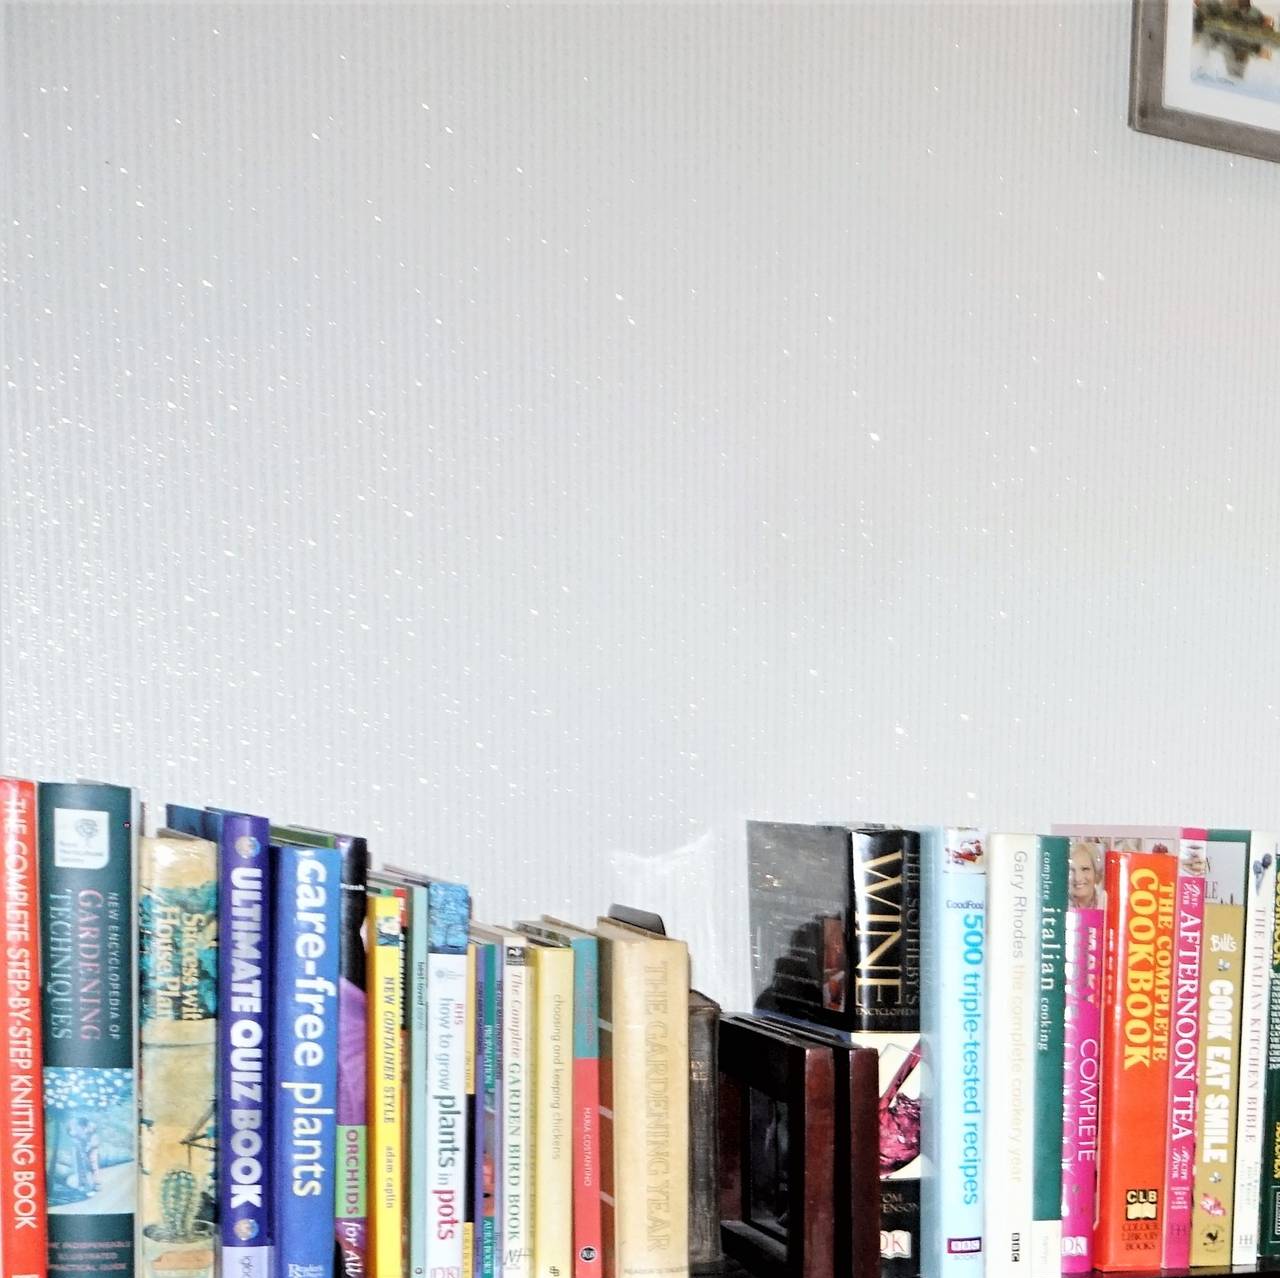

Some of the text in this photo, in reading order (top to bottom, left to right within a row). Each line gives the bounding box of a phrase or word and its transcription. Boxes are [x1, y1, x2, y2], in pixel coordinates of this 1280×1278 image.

[5, 799, 38, 1229] THE COMPLETE STEP-BY-STEP KNITTING BOOK
[49, 889, 75, 1041] TECHNIQUES
[80, 889, 106, 1041] GARDENING
[855, 849, 903, 1007] WINE
[1036, 852, 1061, 1051] complete italian cooking
[1123, 868, 1159, 1070] COOKBOOK
[1152, 882, 1173, 1062] THE COMPLETE
[230, 866, 262, 1207] ULTIMATE QUIZ BOOK
[281, 858, 335, 1196] care-free plants
[384, 977, 395, 1123] NEW CONTAINER STYLE
[507, 972, 523, 1241] The Complete GARDEN BIRD BOOK
[644, 961, 670, 1253] THE GARDENING YEAR
[957, 913, 984, 1206] 500 triple-tested recipes
[1077, 1039, 1098, 1162] COMPLETE
[1172, 911, 1201, 1141] AFTERNOON TEA
[1203, 979, 1234, 1163] COOK EAT SMILE
[1246, 907, 1266, 1144] THE ITALIAN KITCHEN BIBLE
[342, 1220, 363, 1276] for All
[345, 1129, 360, 1215] ORCHIDS
[1011, 1233, 1020, 1263] BBC
[1126, 1190, 1157, 1203] CLB
